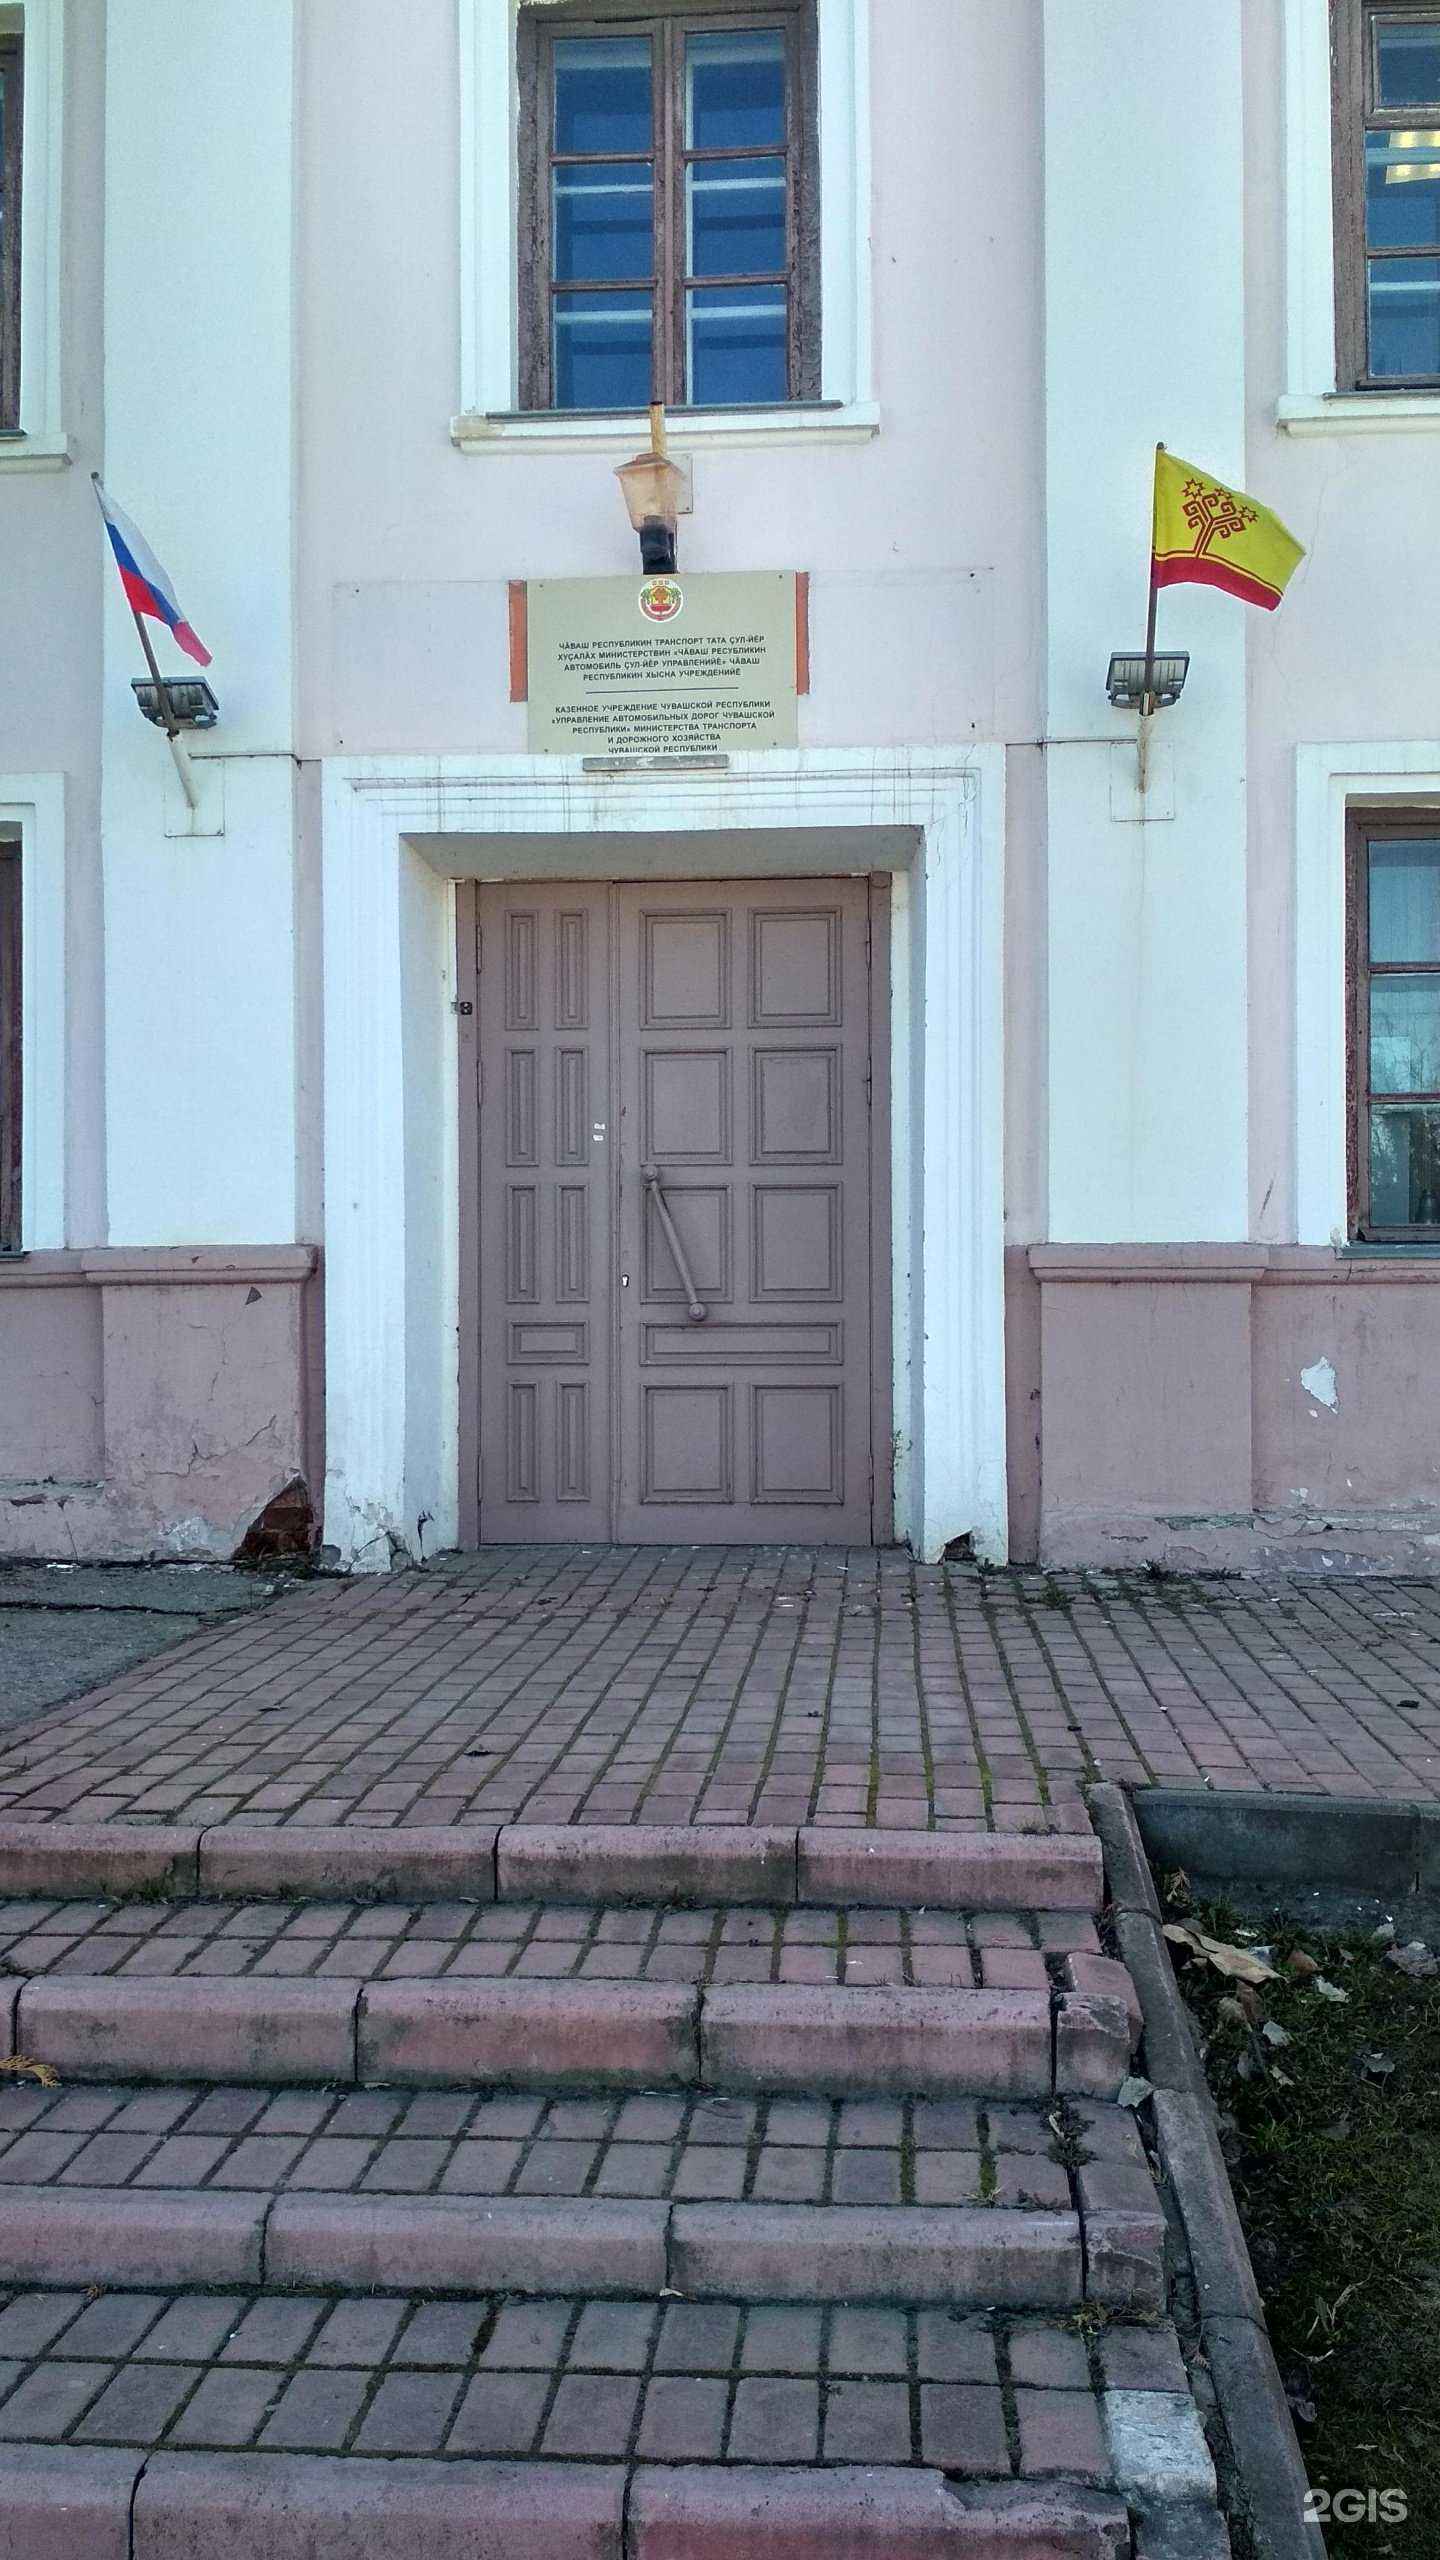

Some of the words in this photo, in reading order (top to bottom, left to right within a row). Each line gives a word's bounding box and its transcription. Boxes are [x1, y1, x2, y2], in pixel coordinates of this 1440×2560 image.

[592, 640, 652, 648] РЕСПУБЛИКИН
[656, 638, 704, 646] ТРАНСПОРТ
[599, 650, 671, 659] МИНИСТЕРСТВИН
[712, 646, 766, 655] РЕСУБЛИКИН
[564, 662, 621, 671] АВТОМОБИЛЬ
[584, 672, 643, 680] РЕСПУБЛИКИН
[646, 670, 676, 678] ХЫСНА
[556, 705, 599, 713] КАЗЕННОЕ
[602, 704, 658, 712] УЧРЕЖДЕНИЕ
[660, 701, 712, 710] ЧУВАШСКОЙ
[716, 700, 770, 708] РЕСПУБЛИКИ
[552, 716, 610, 724] «УПРАВЛЕНИЕ
[612, 713, 688, 722] АВТОМОБИЛЬНЫХ
[691, 712, 720, 720] ДОРОГ
[722, 710, 774, 719] ЧУВАШСКОЙ
[572, 726, 630, 734] РЕСПУБЛИКИ»
[634, 724, 700, 732] МИНИСТЕРСТВА
[702, 722, 757, 730] ТРАНСПОРТА
[616, 735, 670, 744] ДОРОЖНОГО
[672, 732, 721, 742] ХОЗЯЙСТВА
[608, 746, 660, 754] ЧУВАШСКОЙ
[663, 744, 718, 752] РЕСПУБЛИКИ
